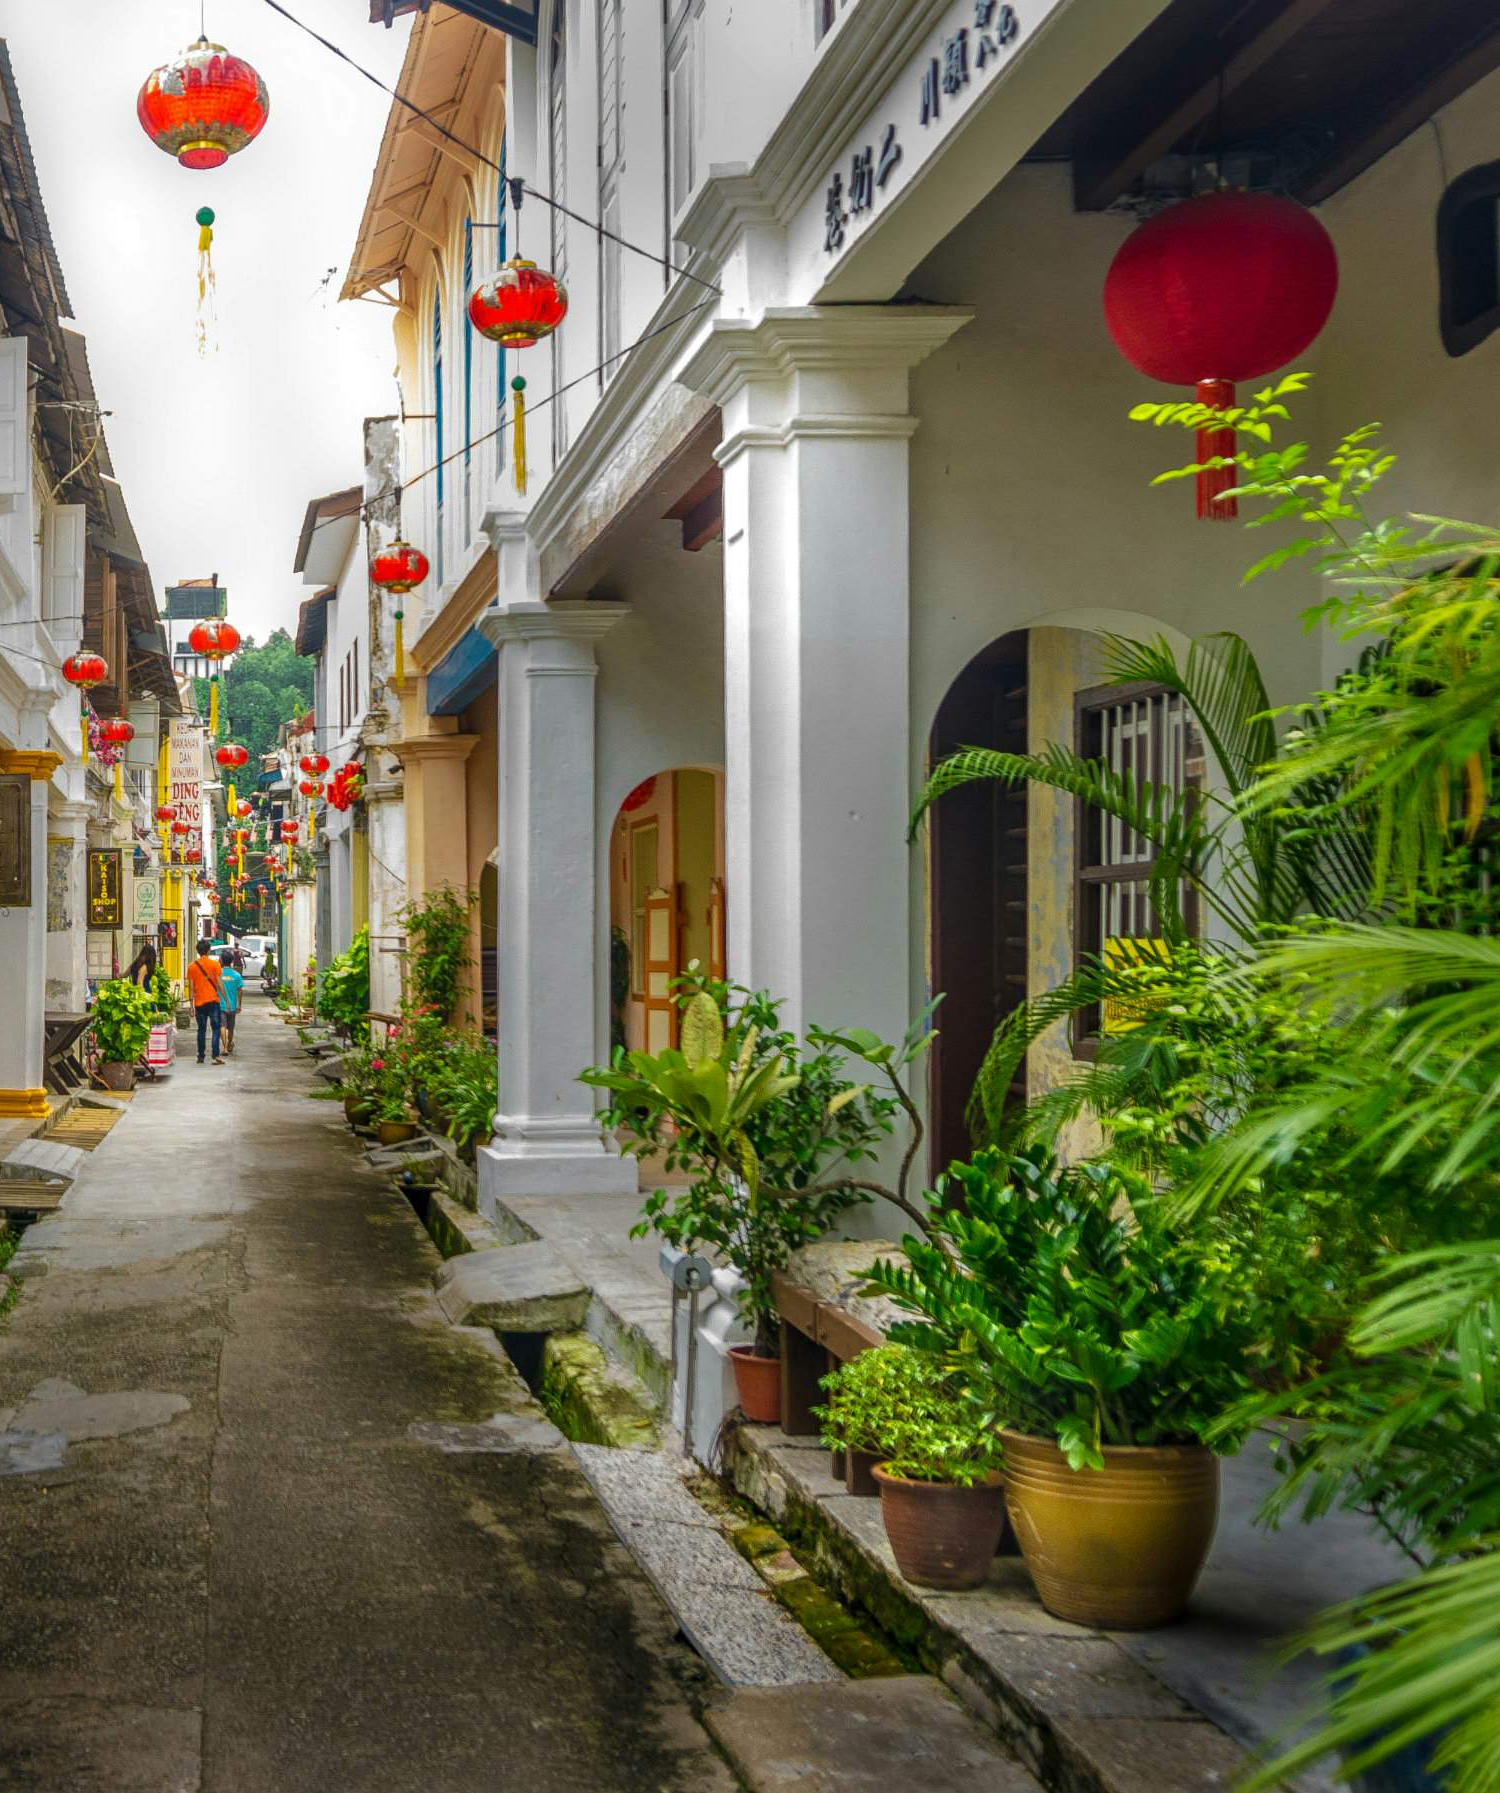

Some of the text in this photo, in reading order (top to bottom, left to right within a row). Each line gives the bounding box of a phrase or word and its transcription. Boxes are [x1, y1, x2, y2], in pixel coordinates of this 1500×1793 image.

[171, 738, 199, 749] MAKANAN
[180, 752, 192, 764] DAN
[171, 767, 199, 778] MINUMAN
[173, 782, 199, 799] DING
[100, 864, 108, 898] KAISO
[92, 898, 116, 906] SHOP
